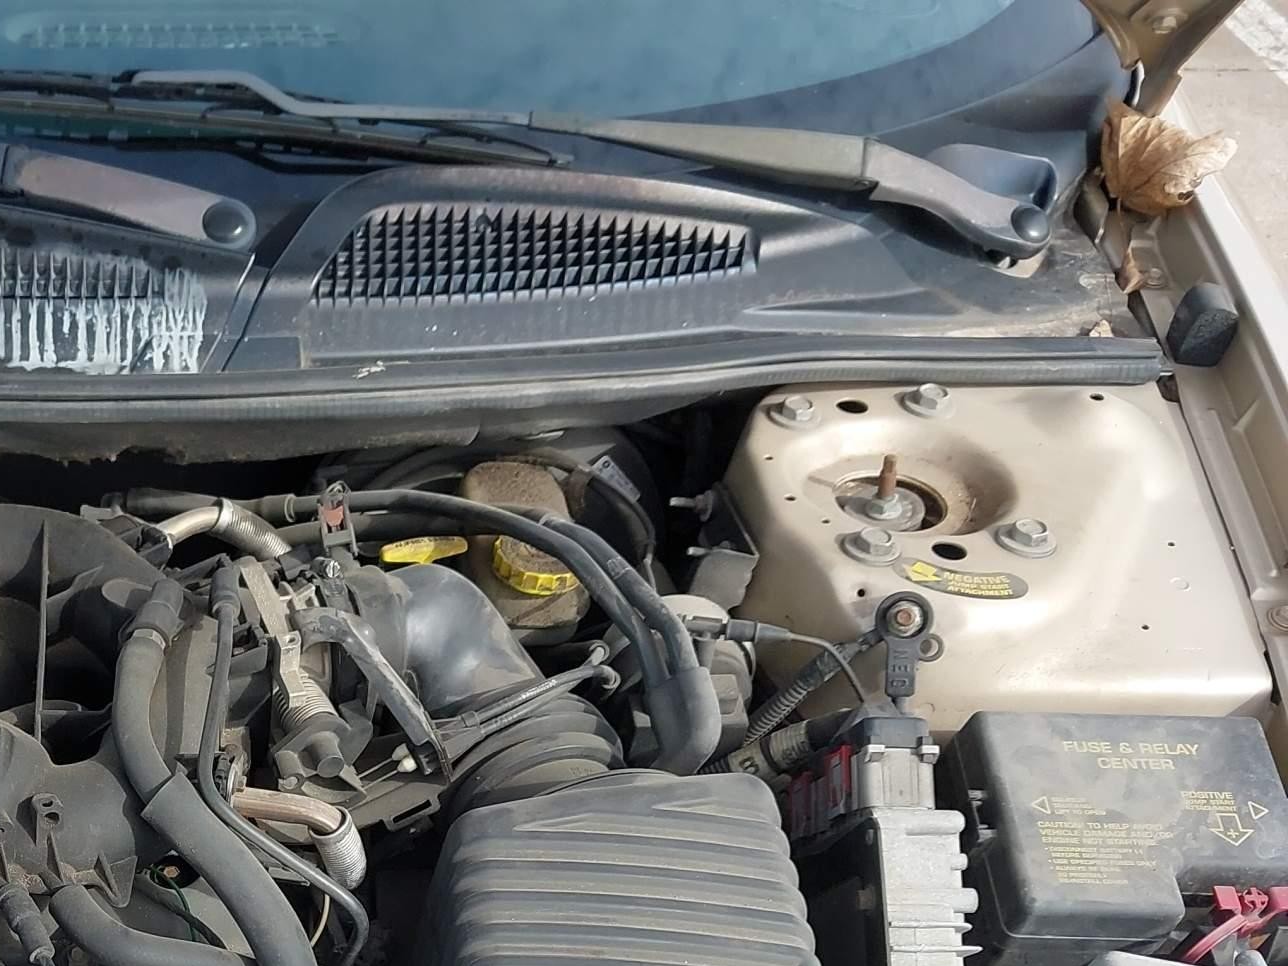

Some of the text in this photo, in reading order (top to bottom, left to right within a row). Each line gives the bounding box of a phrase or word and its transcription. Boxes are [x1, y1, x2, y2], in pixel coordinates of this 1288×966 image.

[944, 572, 1010, 583] NEGATIVE
[947, 586, 1013, 596] ATTACHMENT
[1062, 741, 1199, 756] FUSE & RELAY
[1098, 758, 1176, 770] CENTER
[1086, 822, 1101, 830] TO
